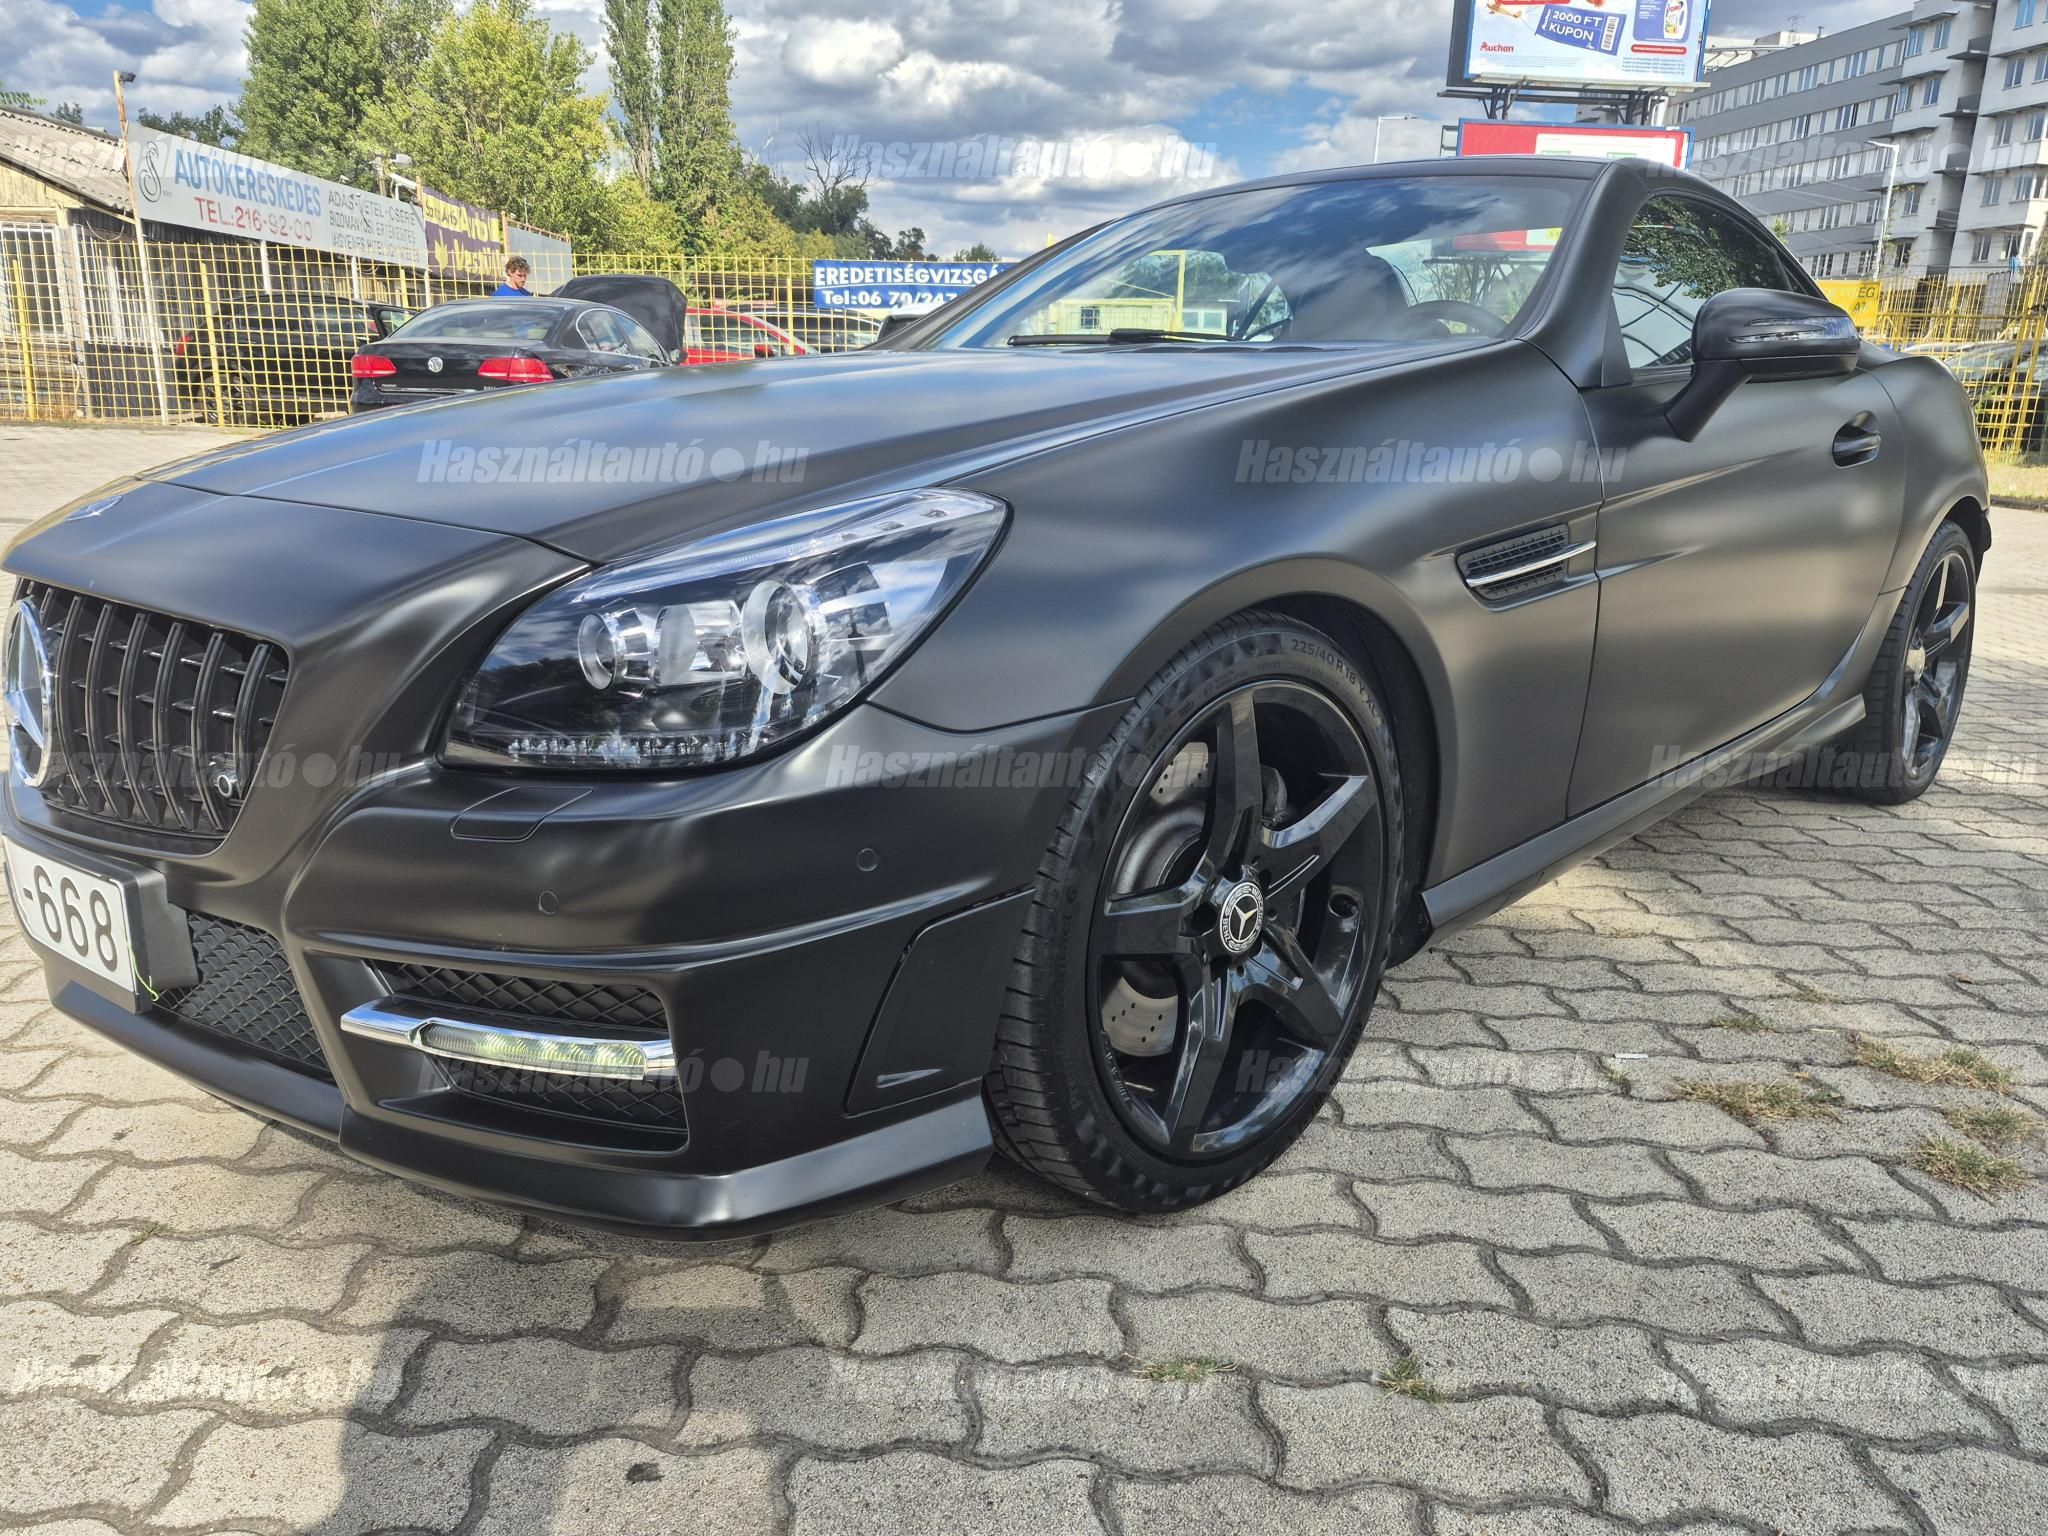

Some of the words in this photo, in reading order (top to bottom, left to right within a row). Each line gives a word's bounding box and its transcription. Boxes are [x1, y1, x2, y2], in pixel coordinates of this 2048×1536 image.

[1552, 10, 1581, 24] 2000
[1583, 16, 1602, 27] FT
[1549, 22, 1594, 41] KUPON
[1479, 41, 1514, 53] Auchan
[815, 264, 1004, 286] EREDETISÉGVIZSGÁ
[822, 290, 882, 306] Tel:06
[1291, 639, 1334, 666] 225/40
[1222, 917, 1231, 943] BENZ
